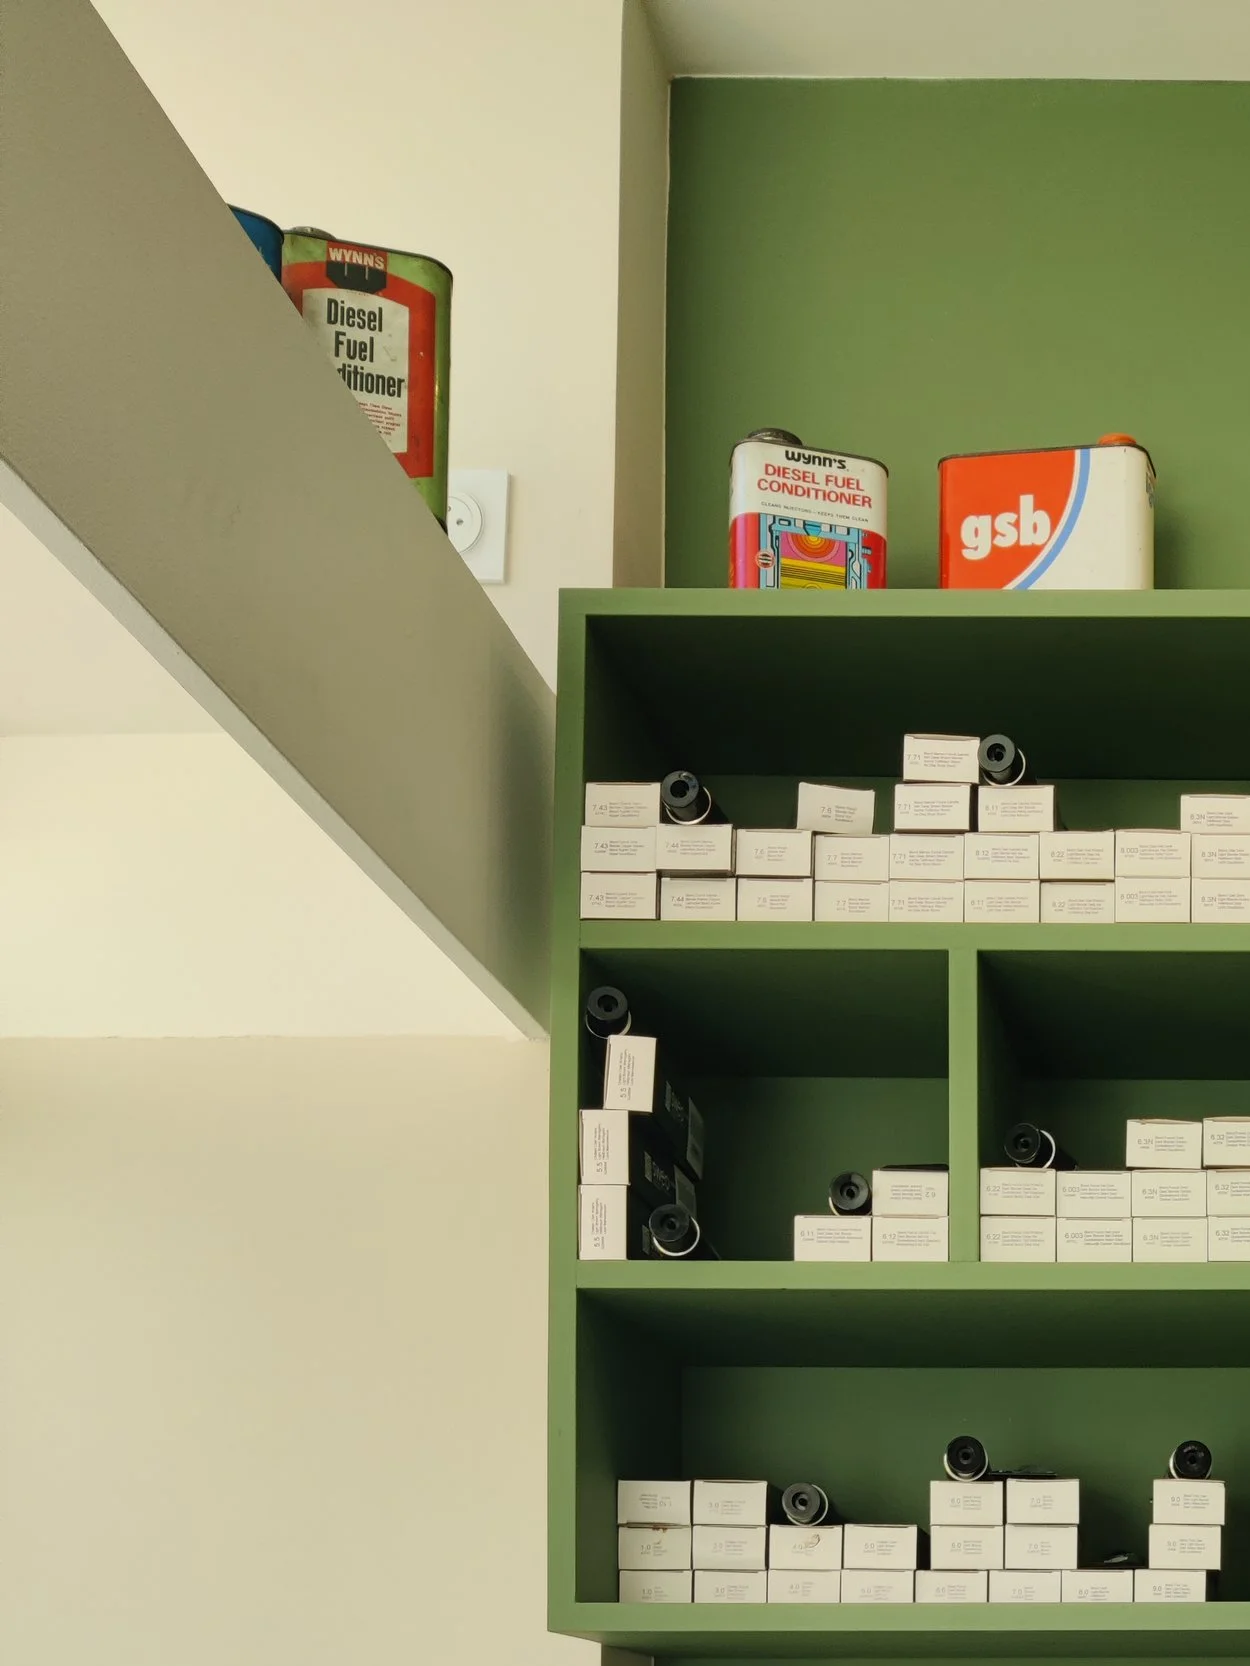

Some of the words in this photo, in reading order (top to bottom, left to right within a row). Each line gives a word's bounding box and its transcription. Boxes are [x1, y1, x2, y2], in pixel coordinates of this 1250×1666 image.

[328, 247, 385, 270] WYNN'S
[327, 297, 383, 333] Diesel
[334, 330, 374, 363] Fuel
[337, 363, 406, 398] ditioner
[757, 478, 872, 508] CONDITIONER
[764, 463, 820, 485] DIESEL
[825, 475, 865, 492] FUEL
[960, 493, 1051, 561] gsb
